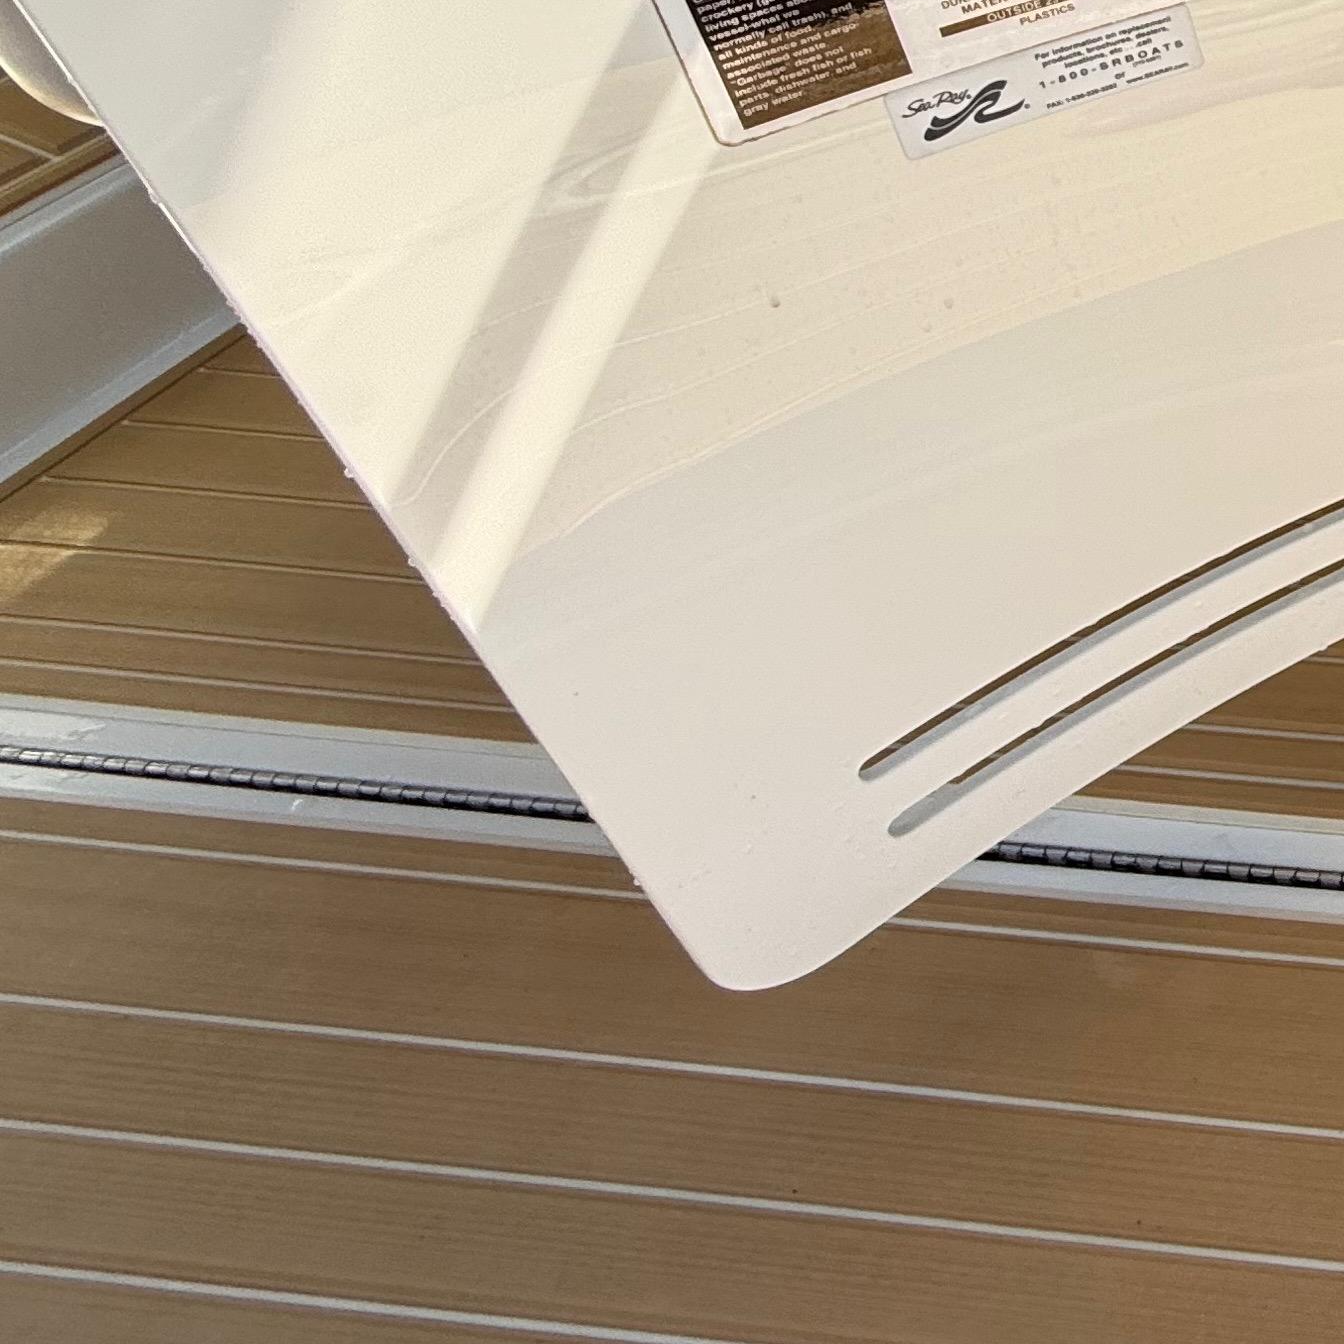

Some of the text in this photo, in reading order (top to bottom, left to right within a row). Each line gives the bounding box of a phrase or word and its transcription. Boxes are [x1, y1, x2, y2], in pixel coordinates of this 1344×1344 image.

[986, 0, 1041, 22] OUTSIDE
[1019, 3, 1075, 25] PLASTICS
[901, 88, 971, 118] Sea Ray
